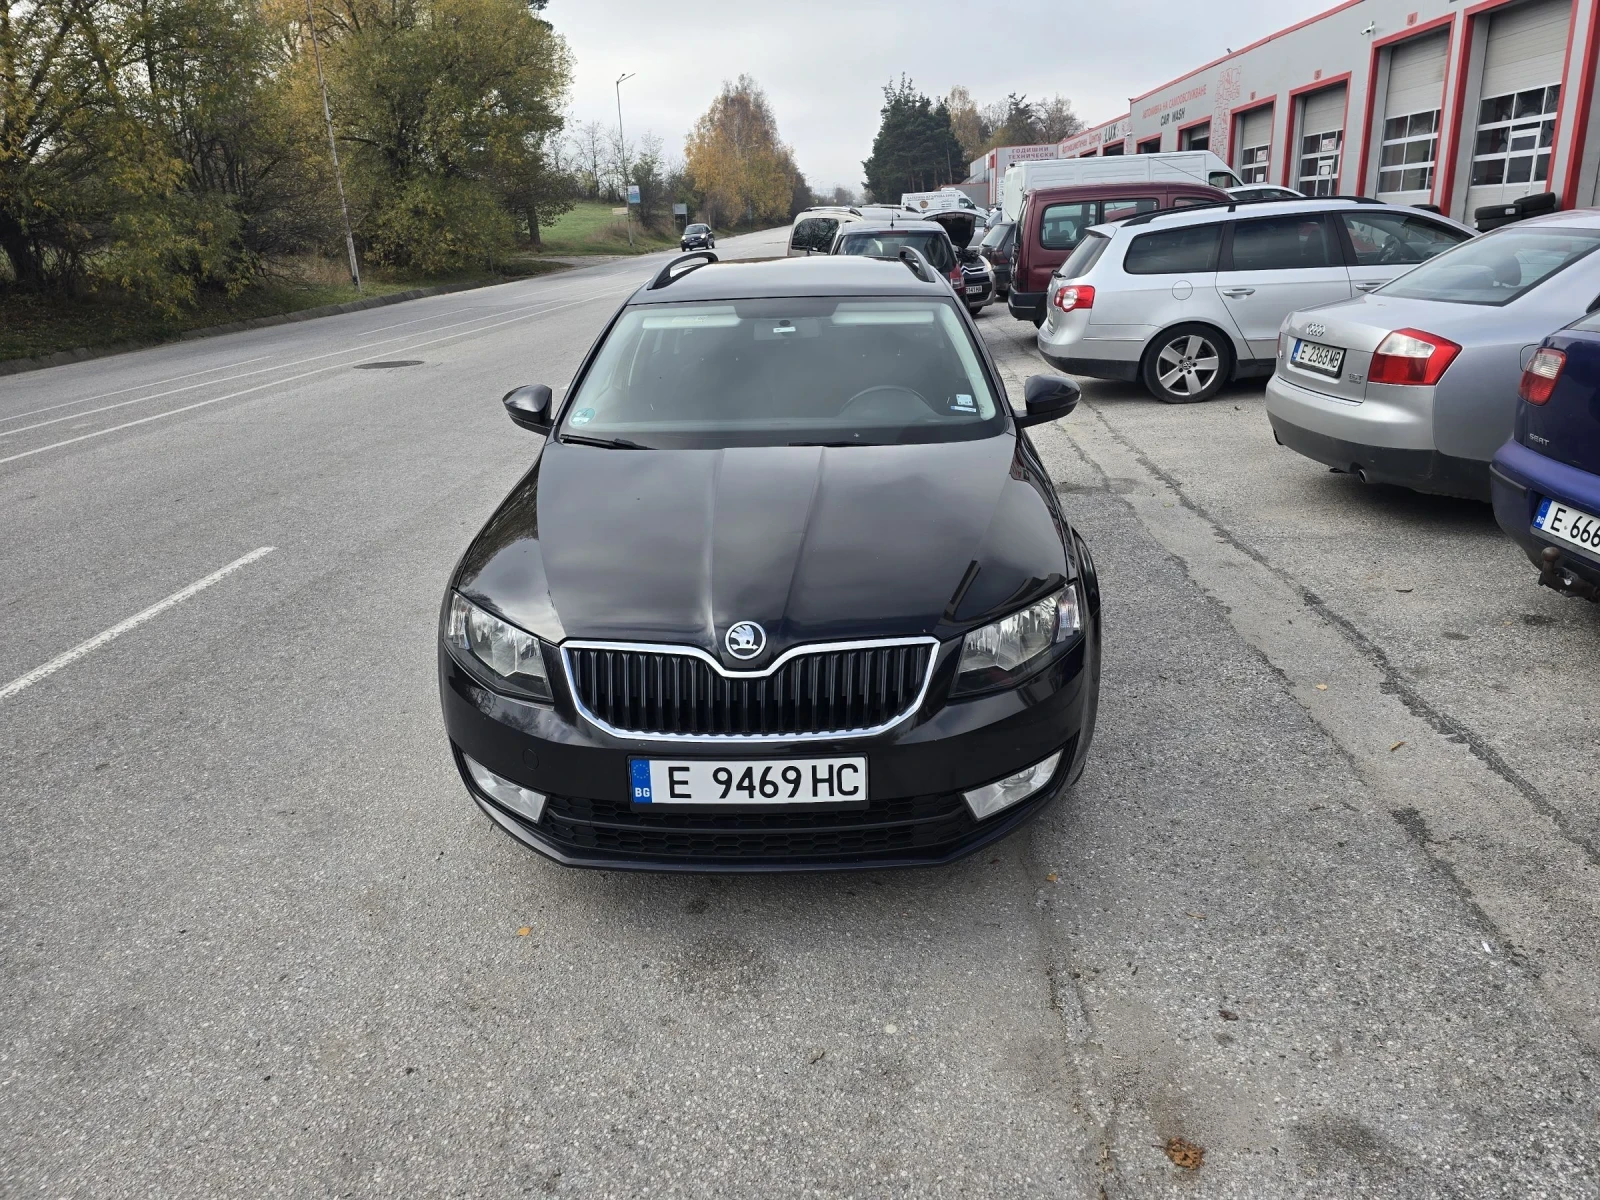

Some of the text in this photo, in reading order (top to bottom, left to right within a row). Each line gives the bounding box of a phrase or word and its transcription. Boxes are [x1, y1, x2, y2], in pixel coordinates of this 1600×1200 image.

[1160, 107, 1186, 127] CAR WASH
[1008, 152, 1054, 160] ТЕХНИЧЕСКИ
[1011, 146, 1049, 154] ГОДИШНИ
[1299, 344, 1340, 368] E 2368 MB
[1529, 433, 1550, 447] SEAT
[1536, 516, 1545, 525] BG
[1549, 507, 1567, 533] E
[668, 763, 860, 799] E 9469 HC
[634, 787, 651, 798] BG
